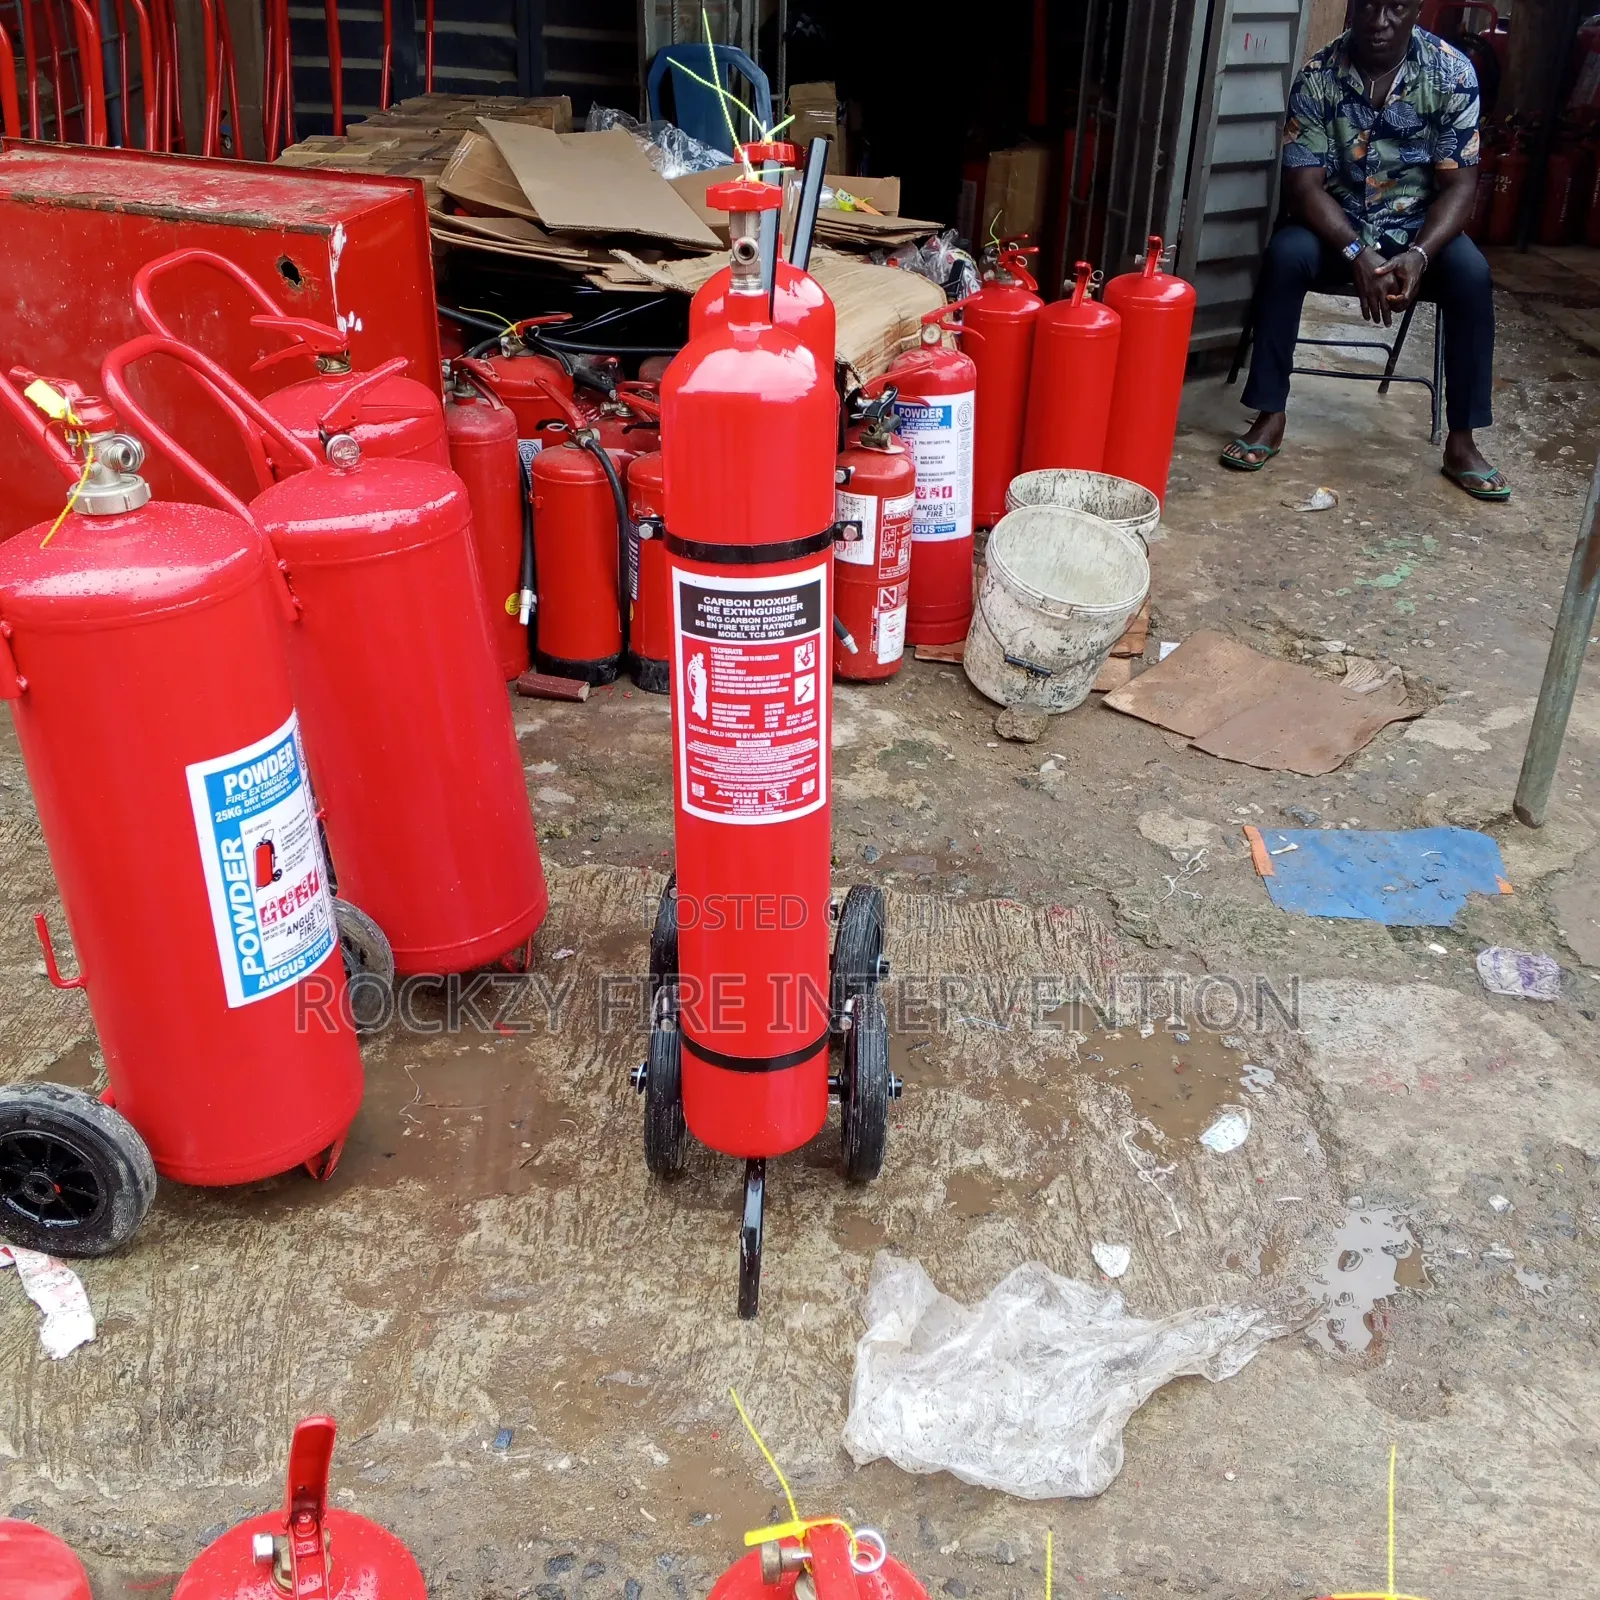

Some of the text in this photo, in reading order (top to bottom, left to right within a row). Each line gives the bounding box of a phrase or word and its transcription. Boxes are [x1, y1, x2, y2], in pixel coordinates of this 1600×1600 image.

[899, 408, 943, 418] POWDER
[914, 525, 936, 533] GUS
[698, 602, 803, 616] FIRE EXTINGUISHER
[703, 595, 797, 607] CARBON DIOXIDE
[695, 619, 705, 627] BS
[762, 621, 792, 631] RATING
[762, 613, 795, 623] DIOXIDE
[223, 742, 294, 796] POWDER
[225, 793, 248, 805] FIRE
[244, 796, 259, 808] DRY
[260, 779, 289, 800] CHEMICAL
[215, 805, 242, 823] 25KG
[270, 881, 307, 910] A B C
[220, 836, 264, 976] POWDER
[286, 909, 314, 937] ANGUS
[300, 919, 316, 939] FIRE
[259, 956, 306, 989] ANGUS
